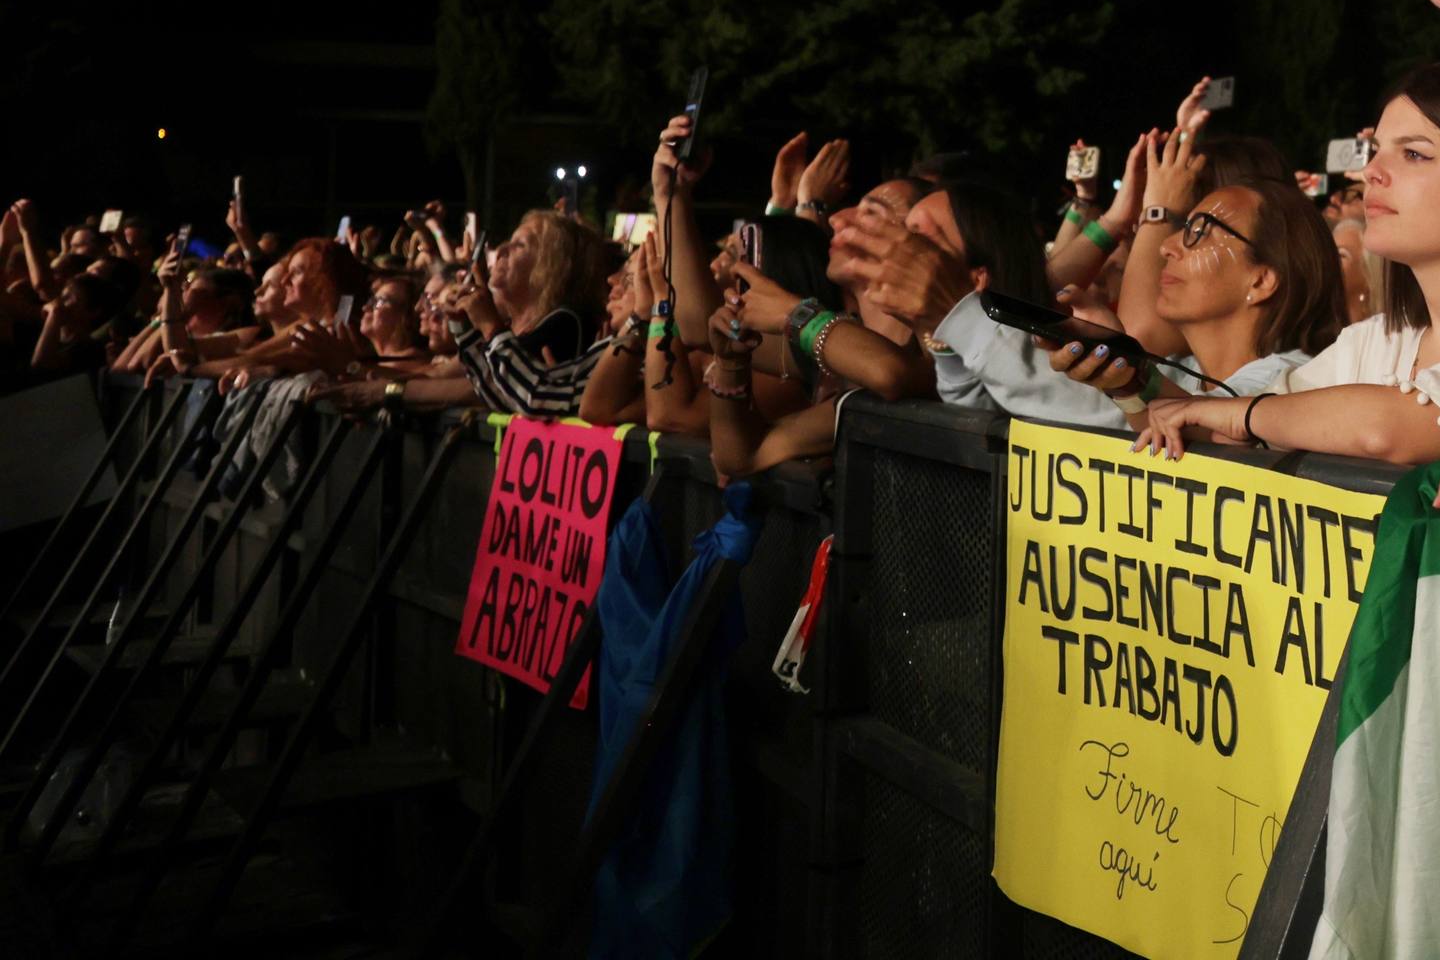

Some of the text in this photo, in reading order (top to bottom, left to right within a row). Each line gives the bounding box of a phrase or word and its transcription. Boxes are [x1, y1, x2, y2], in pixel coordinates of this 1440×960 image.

[500, 432, 609, 519] LOLITO
[1010, 444, 1380, 605] JUSTIFICANTE
[488, 501, 593, 588] DAME UN
[1018, 539, 1334, 691] AUSENCIA AL
[1041, 625, 1238, 758] TRABAJO
[1079, 740, 1180, 844] Firme
[1099, 841, 1160, 901] aquí
